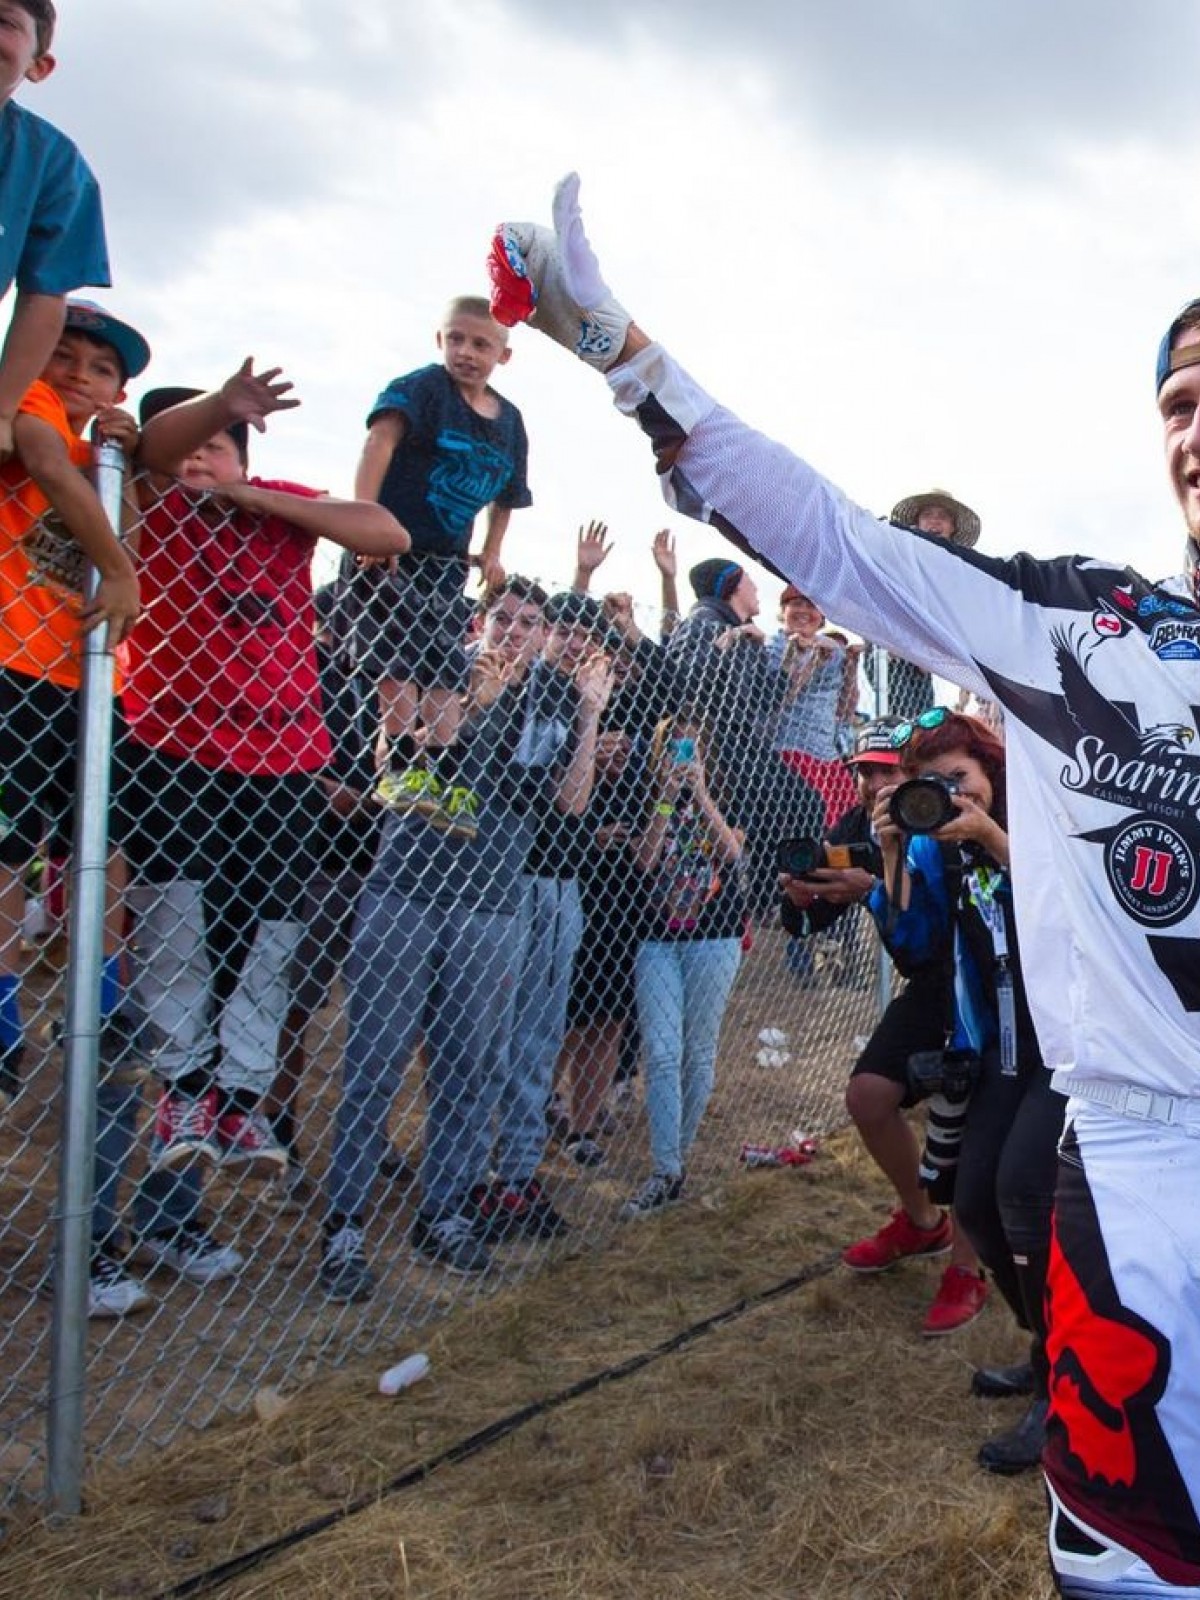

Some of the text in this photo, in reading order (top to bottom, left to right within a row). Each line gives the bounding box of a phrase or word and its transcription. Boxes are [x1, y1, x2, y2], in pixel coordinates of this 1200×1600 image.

[1115, 827, 1190, 878] JIMMY JOHN'S
[1130, 845, 1174, 896] JJ
